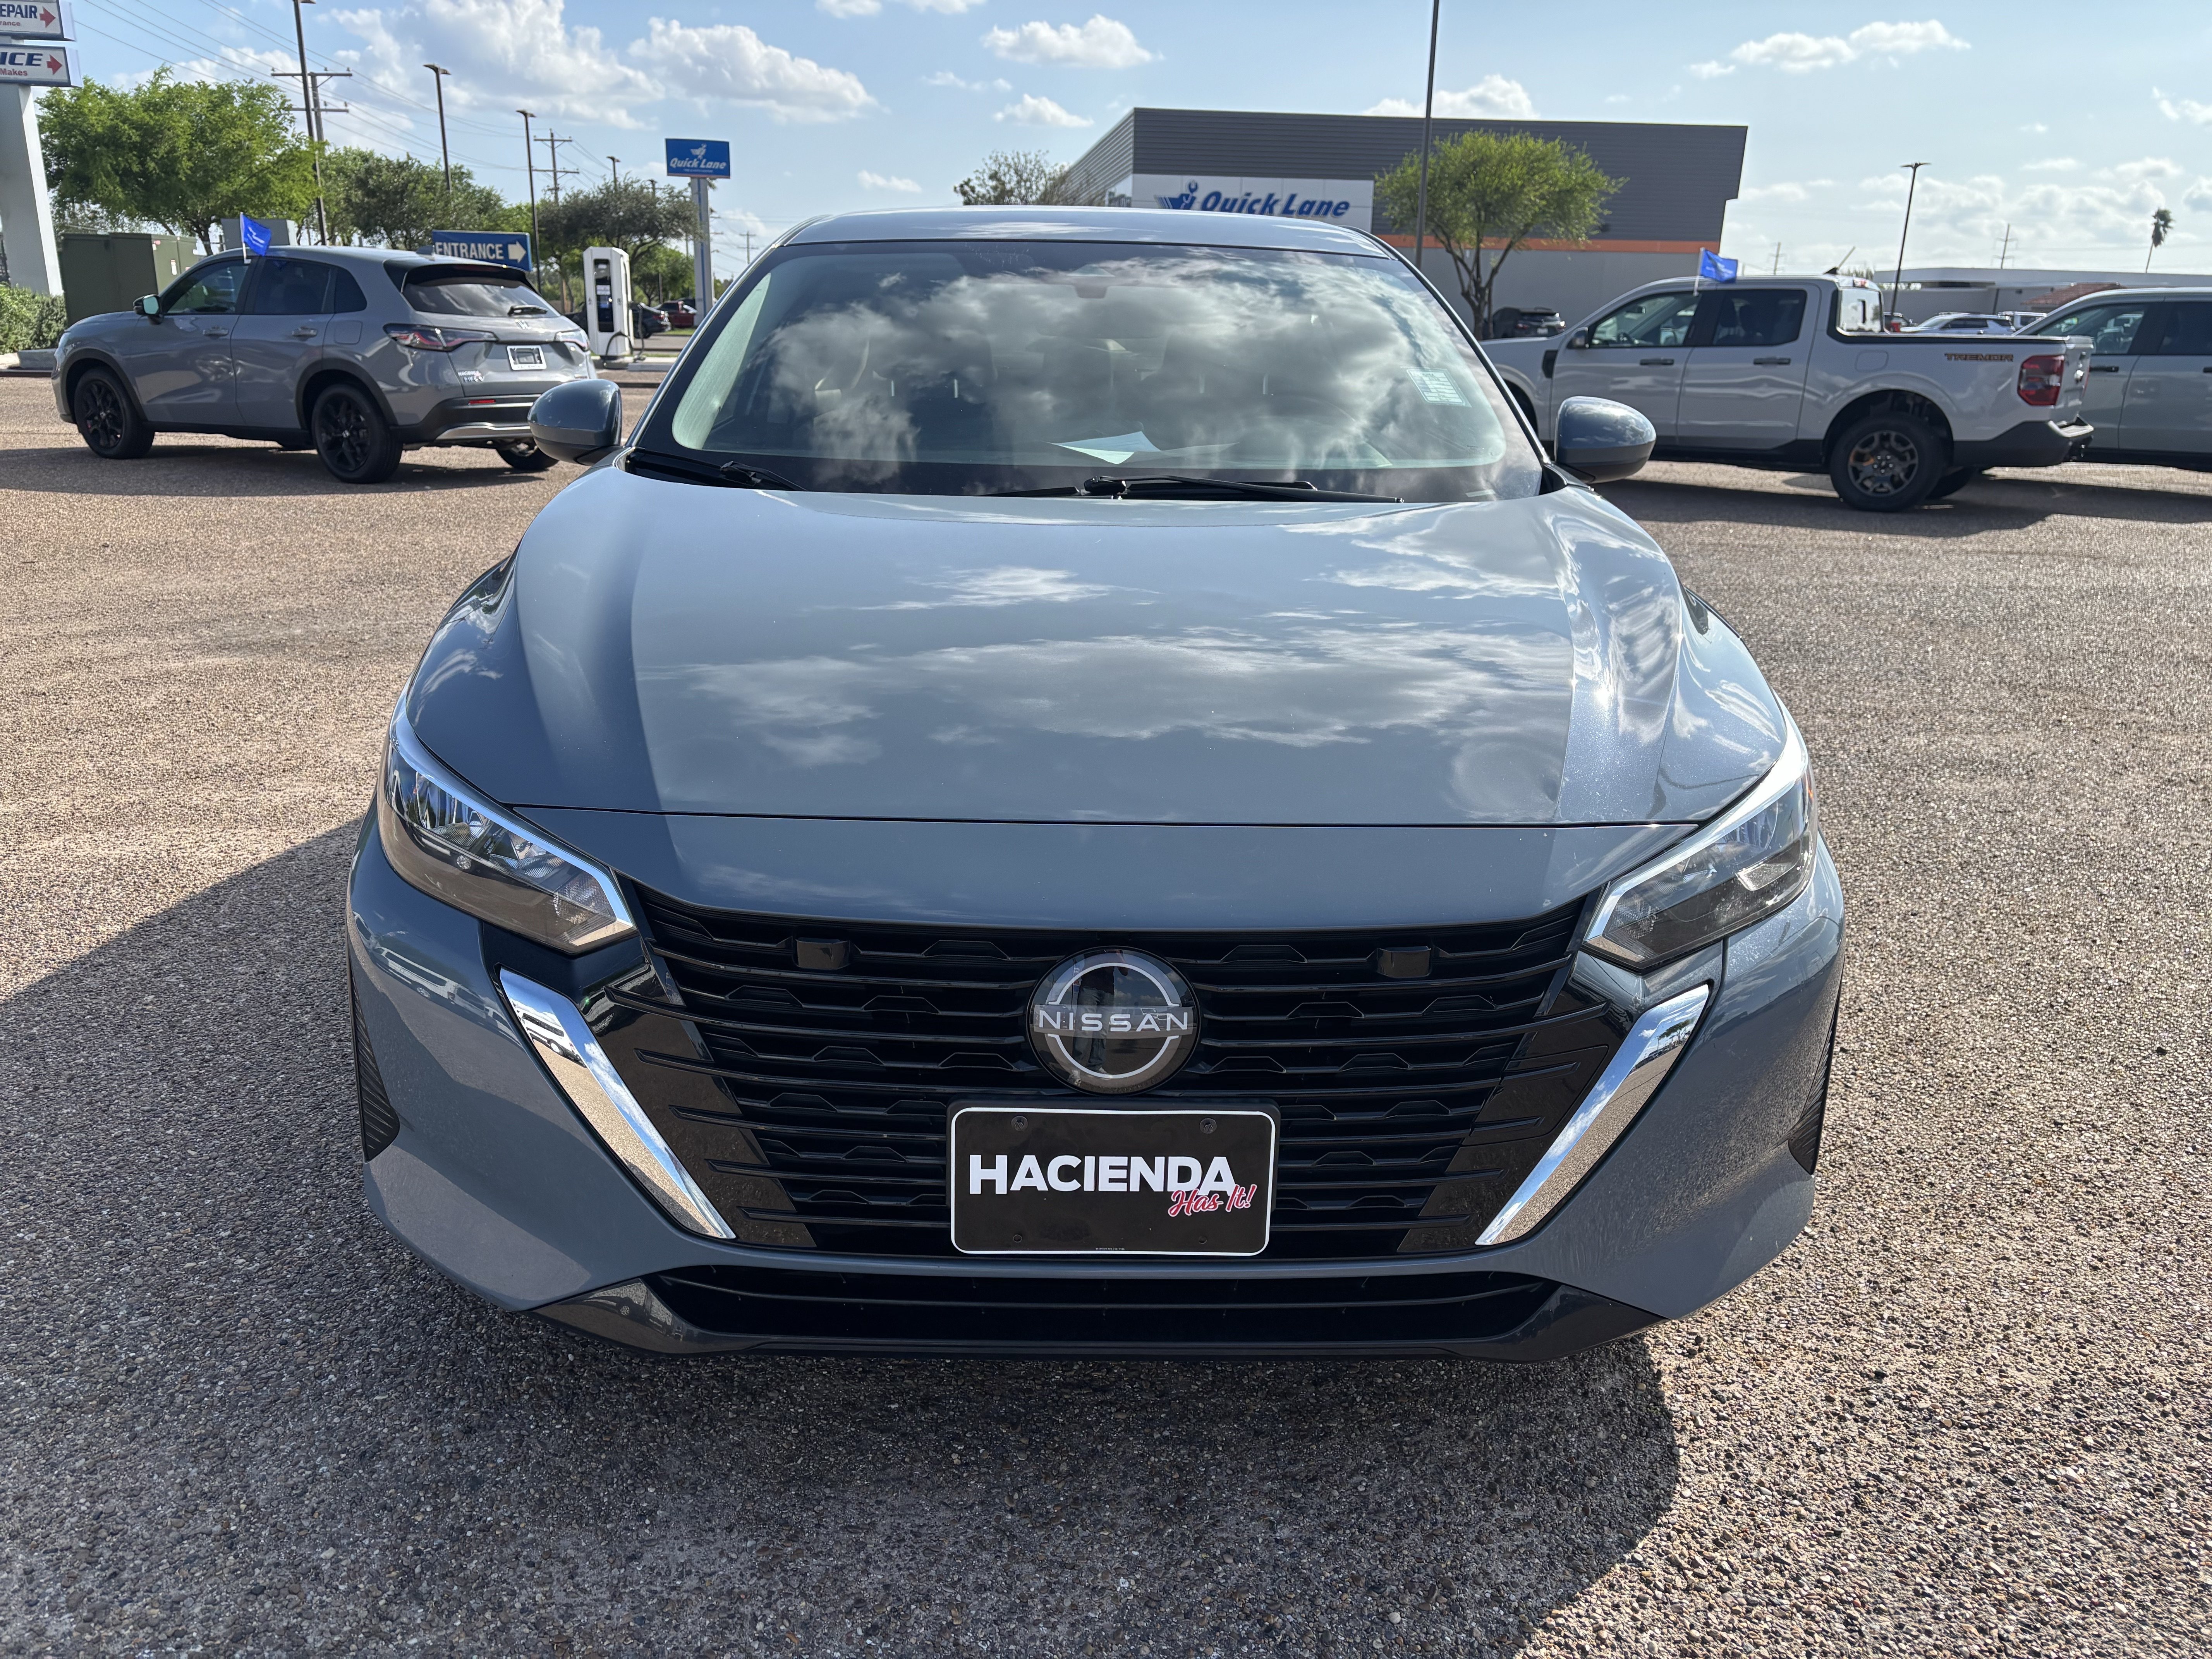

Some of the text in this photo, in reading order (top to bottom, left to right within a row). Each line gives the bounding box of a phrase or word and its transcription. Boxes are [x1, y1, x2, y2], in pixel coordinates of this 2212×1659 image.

[0, 68, 27, 76] Makes
[670, 157, 727, 169] Quick Lane
[1201, 191, 1350, 217] Quick Lane
[435, 242, 504, 260] ENTRANCE
[1944, 353, 2014, 362] TREMOR
[1039, 1010, 1188, 1032] NISSAN
[969, 1155, 1236, 1196] HACIENDA
[1168, 1184, 1257, 1217] Has It!
